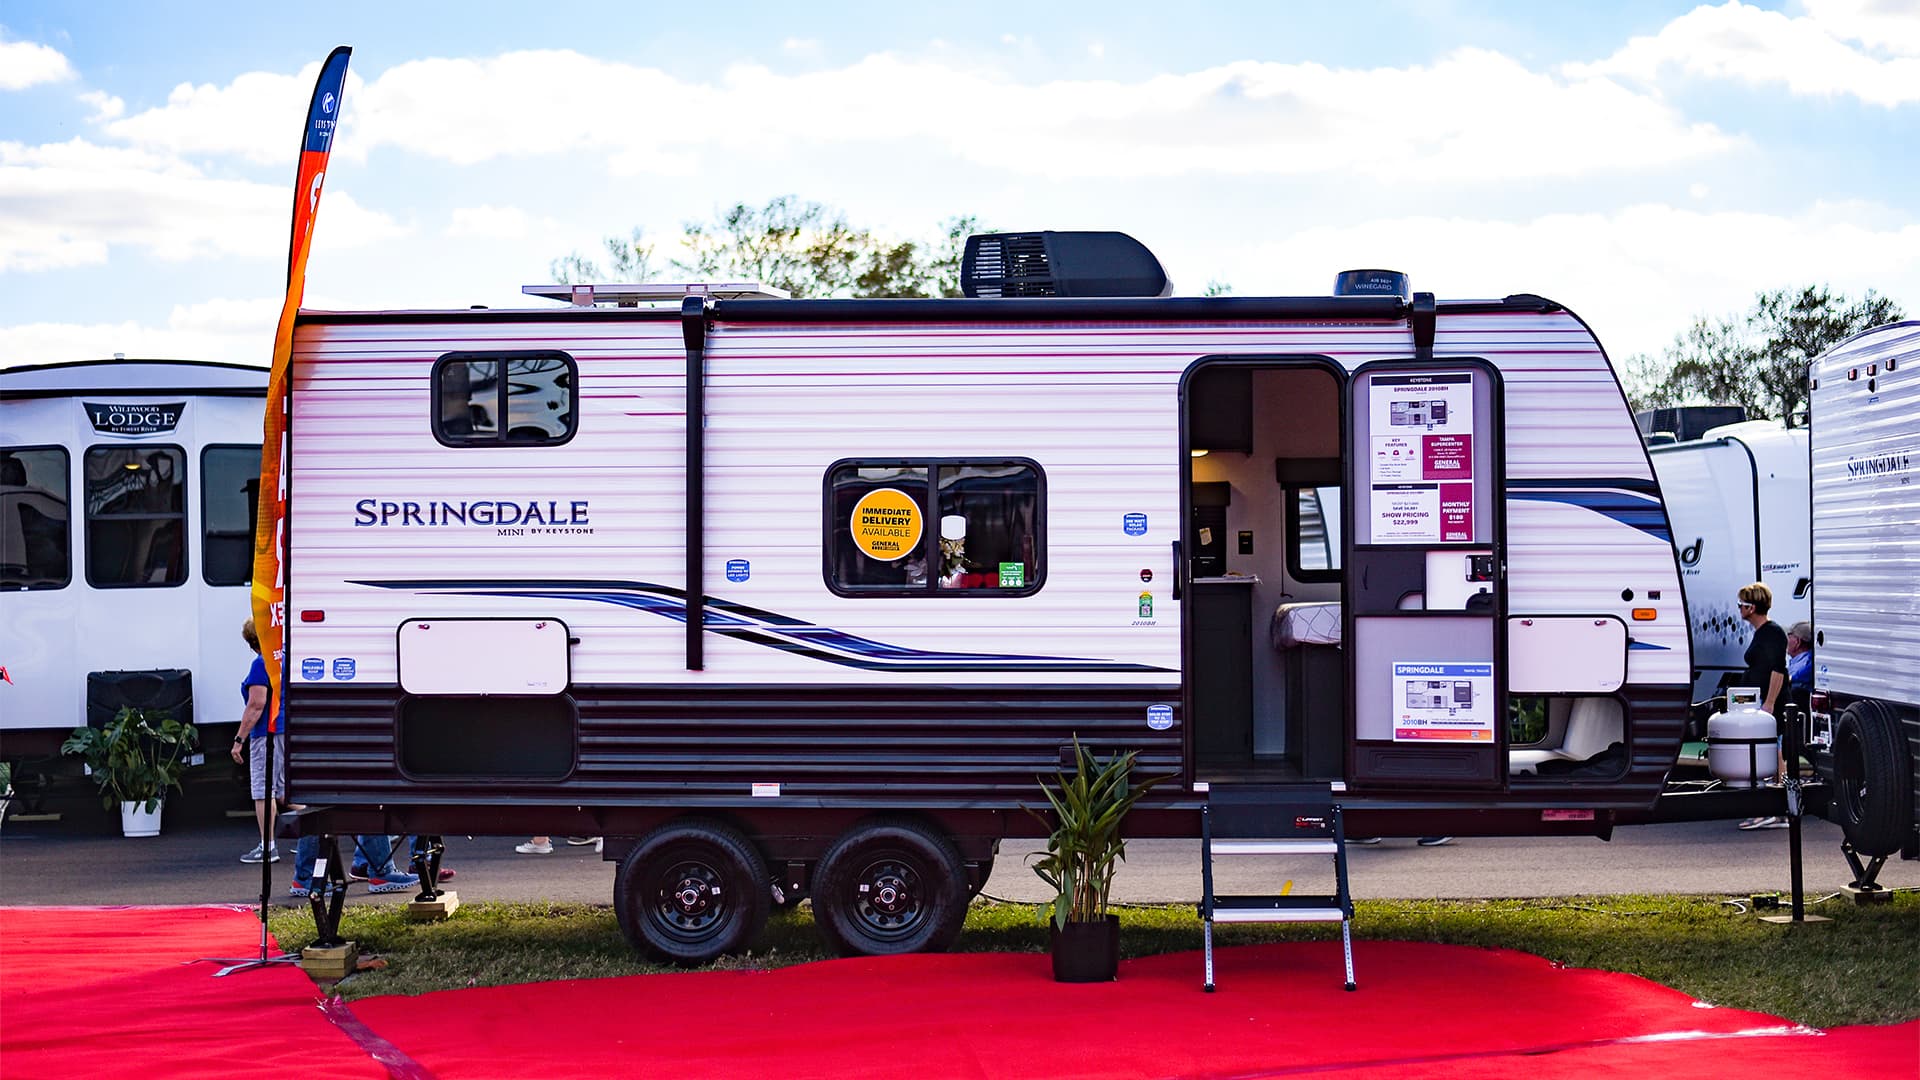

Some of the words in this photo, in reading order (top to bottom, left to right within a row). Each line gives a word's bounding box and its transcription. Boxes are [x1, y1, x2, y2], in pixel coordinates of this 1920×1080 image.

[1354, 283, 1392, 291] WINEGARD
[95, 412, 176, 426] LODGE
[1848, 450, 1910, 481] SPRINGDALE
[354, 498, 590, 527] SPRINGDALE
[862, 507, 912, 516] IMMEDIATE
[862, 516, 911, 526] DELIVERY
[497, 528, 525, 537] MINI
[861, 527, 911, 538] AVAILABLE
[1397, 666, 1444, 674] SPRINGDALE
